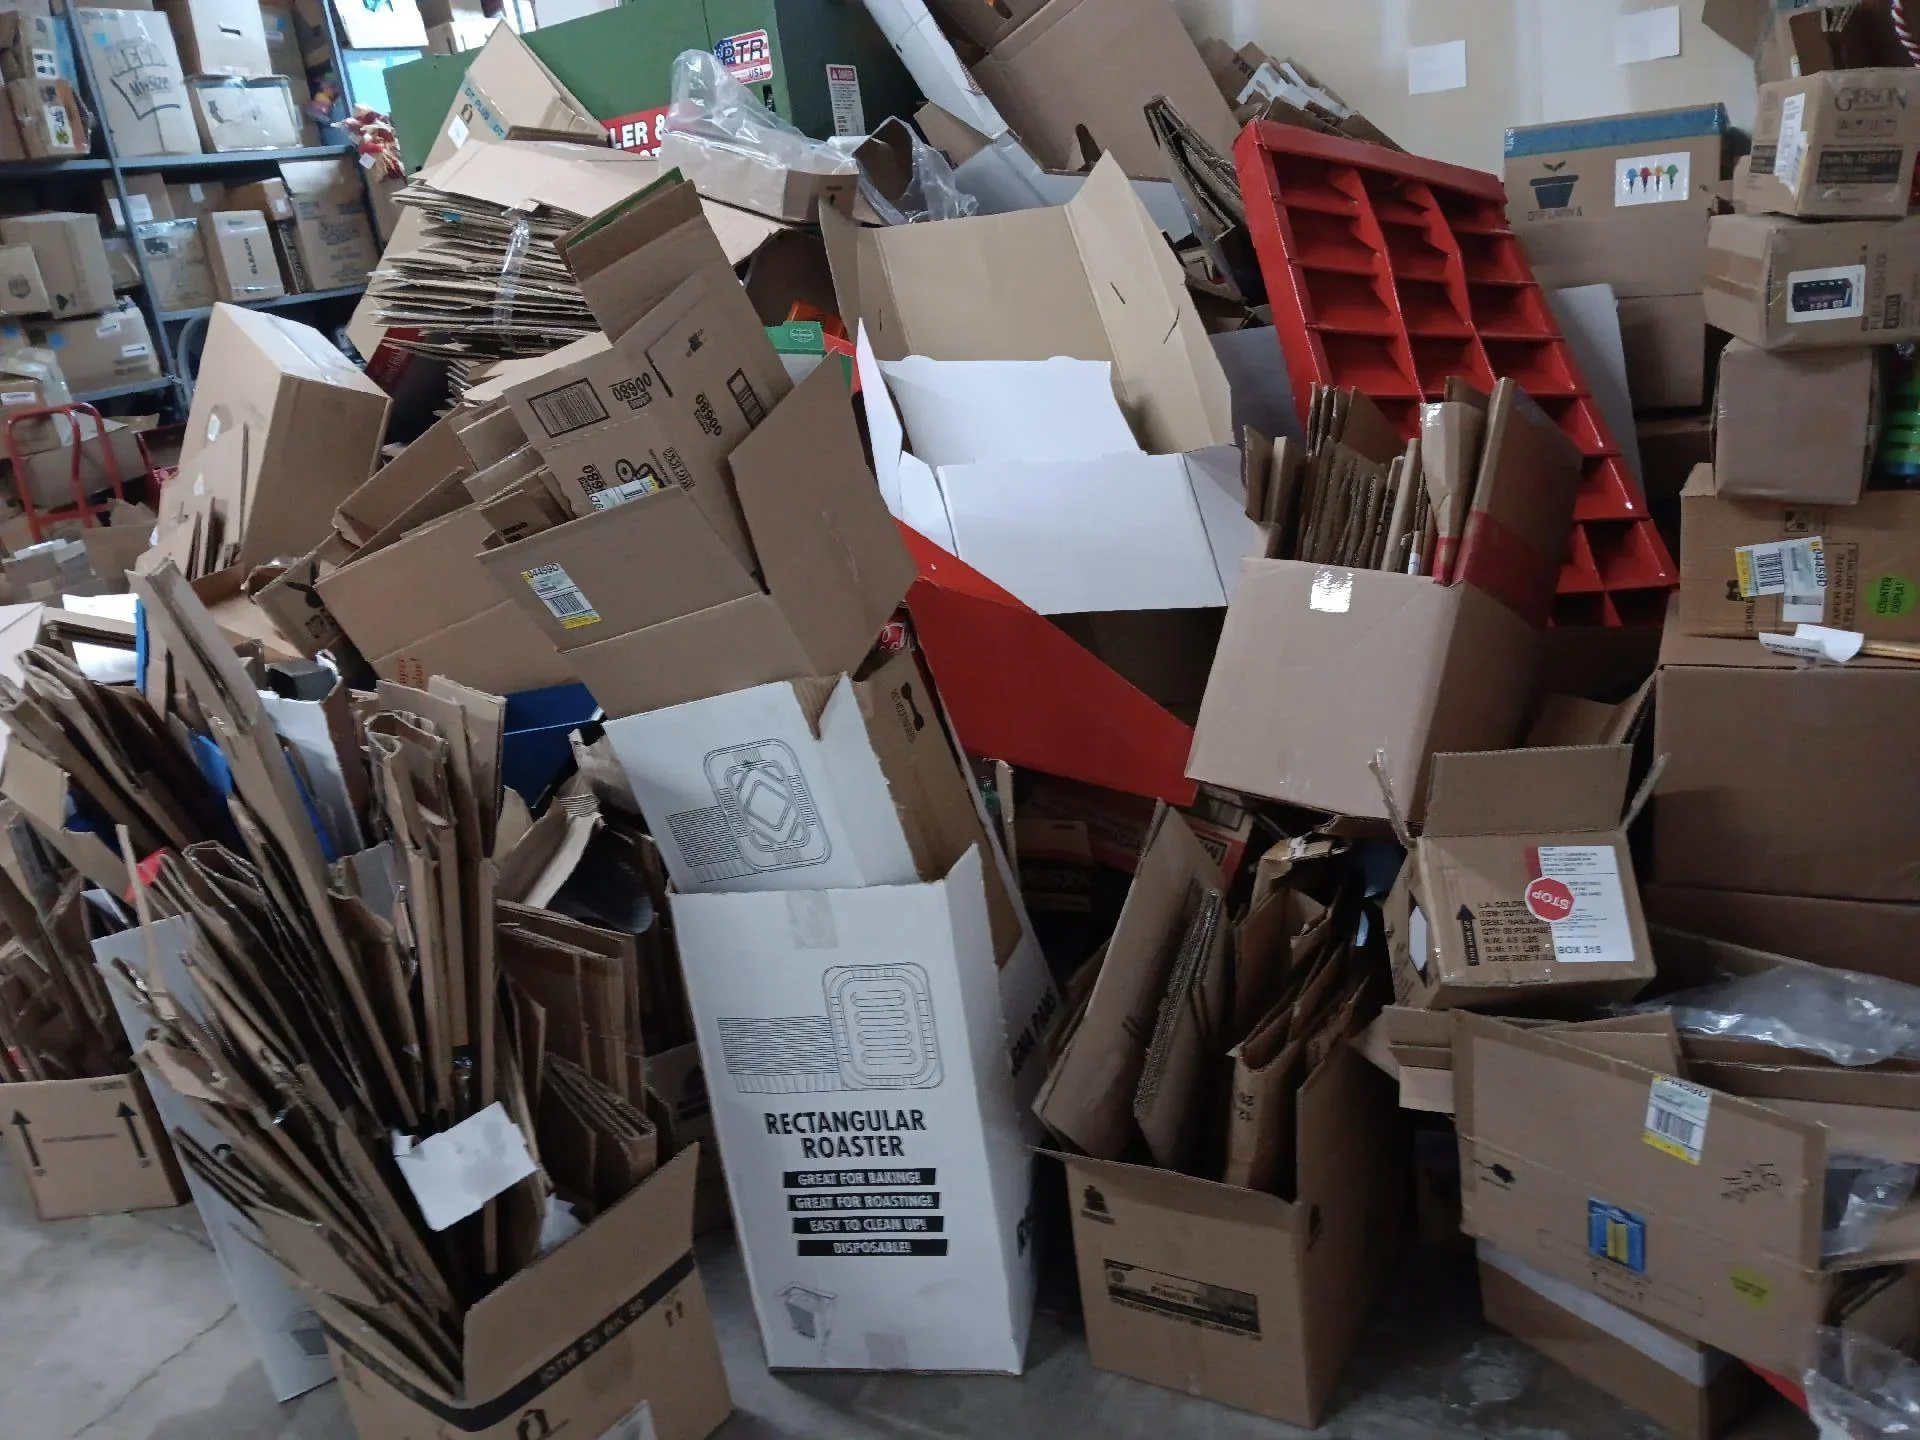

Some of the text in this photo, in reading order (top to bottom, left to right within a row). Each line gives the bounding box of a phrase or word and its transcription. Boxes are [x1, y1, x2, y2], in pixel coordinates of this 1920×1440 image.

[720, 39, 764, 66] PTR
[749, 67, 764, 79] USA
[608, 121, 649, 150] LER
[611, 372, 652, 402] 08900
[1876, 576, 1893, 614] COUNTER
[1531, 889, 1570, 910] STOP
[1557, 945, 1602, 954] BOX 315
[763, 1109, 927, 1135] RECTANGULAR
[800, 1136, 905, 1158] ROASTER
[797, 1171, 922, 1185] GREAT FOR BAKING!
[795, 1195, 934, 1209] GREAT FOR ROASTING!
[809, 1218, 928, 1232] EASY TO CLEAN UP!
[832, 1241, 912, 1254] DISPOSABLE!
